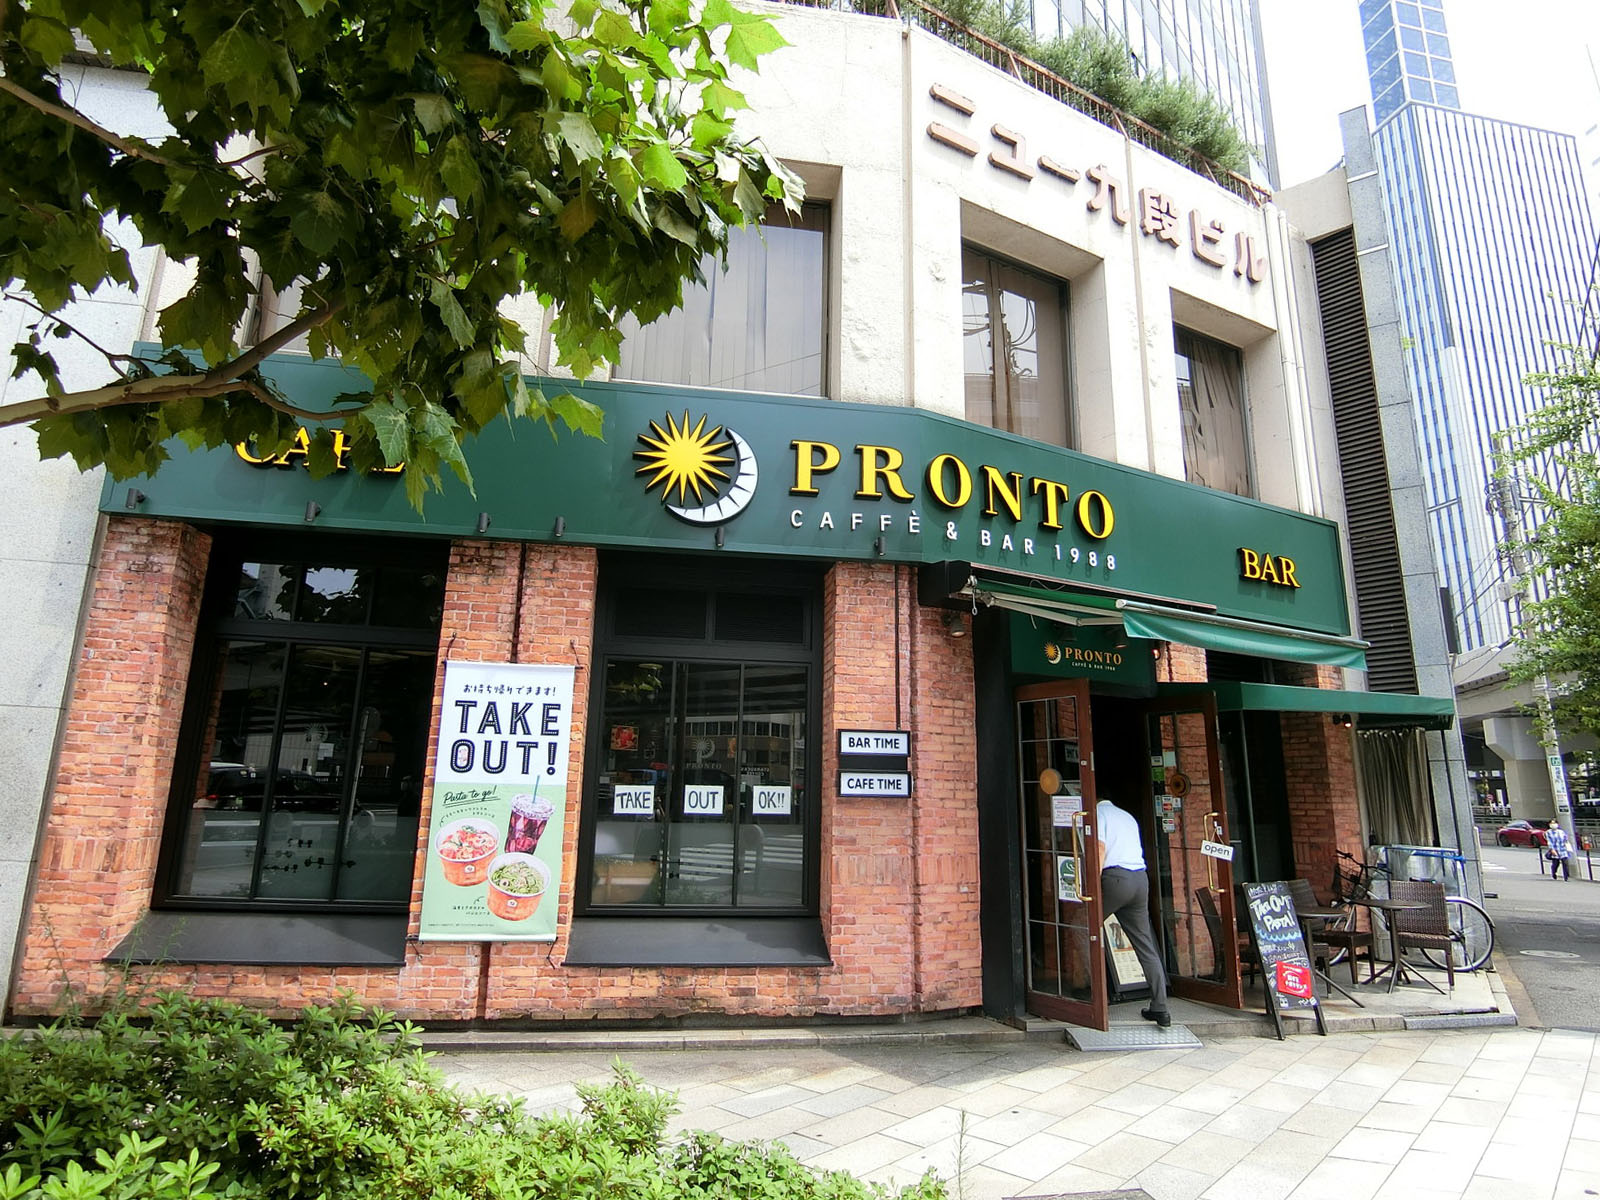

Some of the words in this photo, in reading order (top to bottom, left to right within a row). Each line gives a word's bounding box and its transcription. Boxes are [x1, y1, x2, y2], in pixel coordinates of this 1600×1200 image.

[926, 82, 1266, 283] ニュー九段ビル
[235, 425, 405, 473] CAF
[789, 440, 1115, 540] PRONTO
[791, 510, 921, 534] CAFFÈ
[946, 521, 958, 541] &
[981, 529, 1034, 555] BAR
[1054, 544, 1116, 571] 1988
[1238, 547, 1301, 588] BAR
[1065, 647, 1122, 665] PRONTO
[455, 700, 561, 736] TAKE
[450, 739, 558, 776] OUT!
[848, 737, 871, 748] BAR
[874, 738, 900, 749] TIME
[468, 789, 480, 798] to
[616, 791, 652, 809] TAKE
[688, 791, 719, 809] OUT
[758, 791, 785, 809] OK!!
[847, 778, 874, 790] CAFE
[877, 778, 902, 790] TIME
[1204, 844, 1230, 856] open
